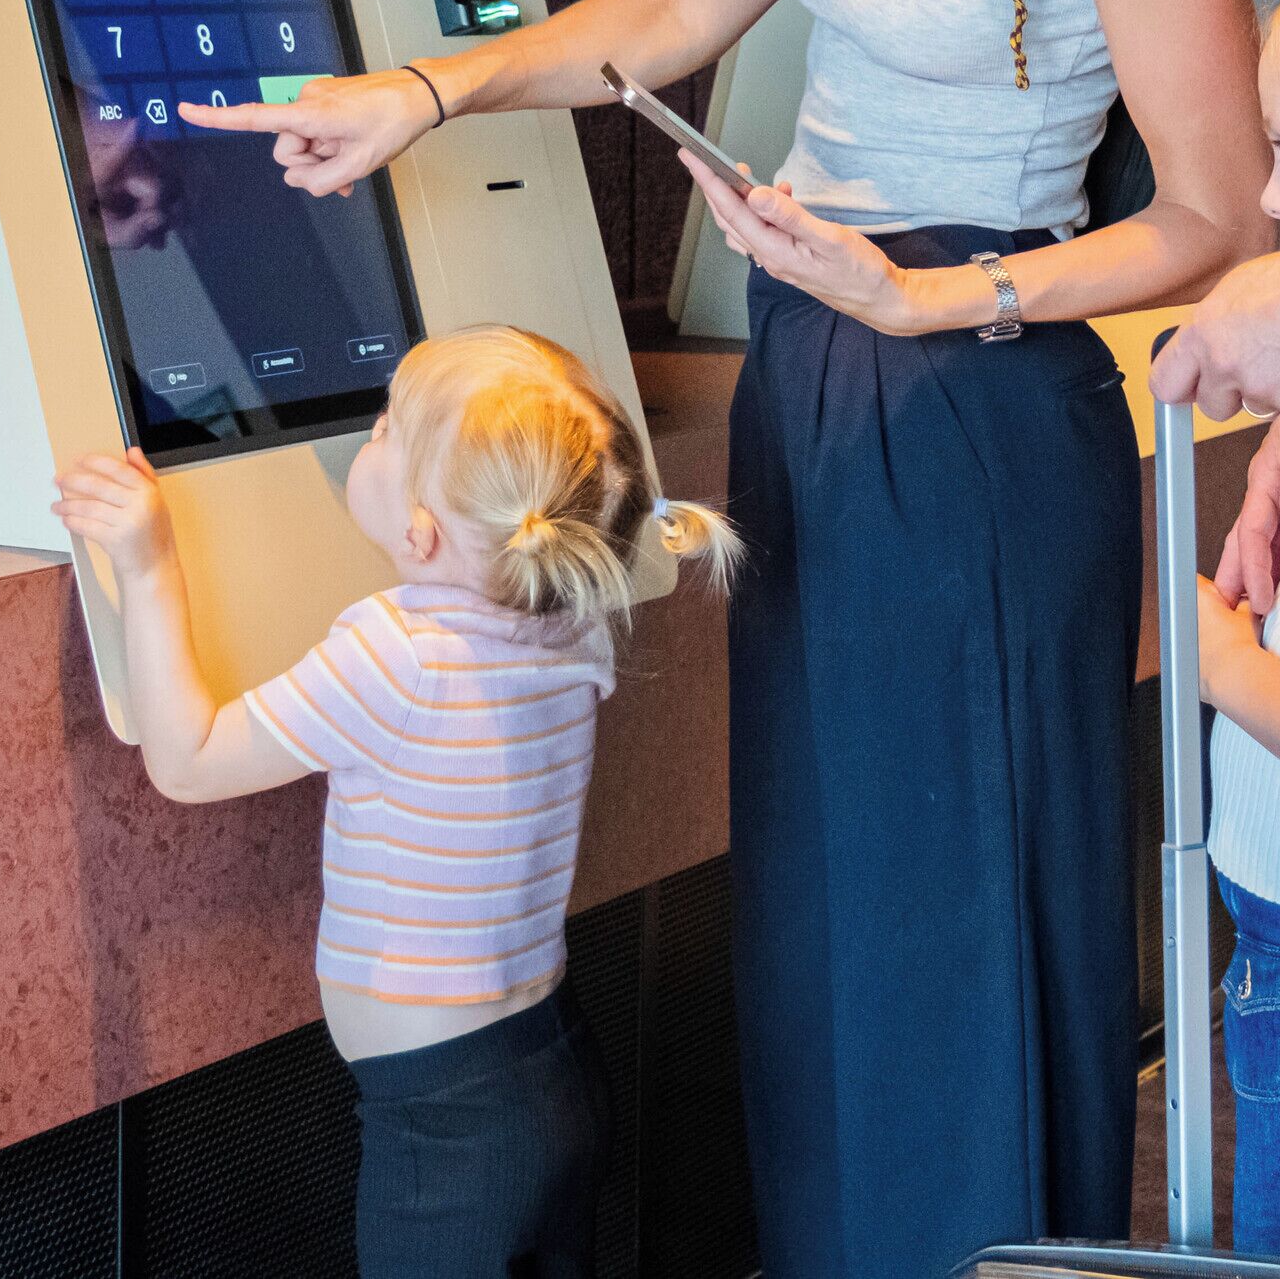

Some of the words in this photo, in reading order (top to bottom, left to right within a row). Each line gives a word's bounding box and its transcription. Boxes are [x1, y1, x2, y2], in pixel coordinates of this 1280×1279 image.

[107, 26, 123, 59] 7
[196, 23, 215, 56] 8
[278, 21, 296, 53] 9
[99, 104, 123, 122] ABC
